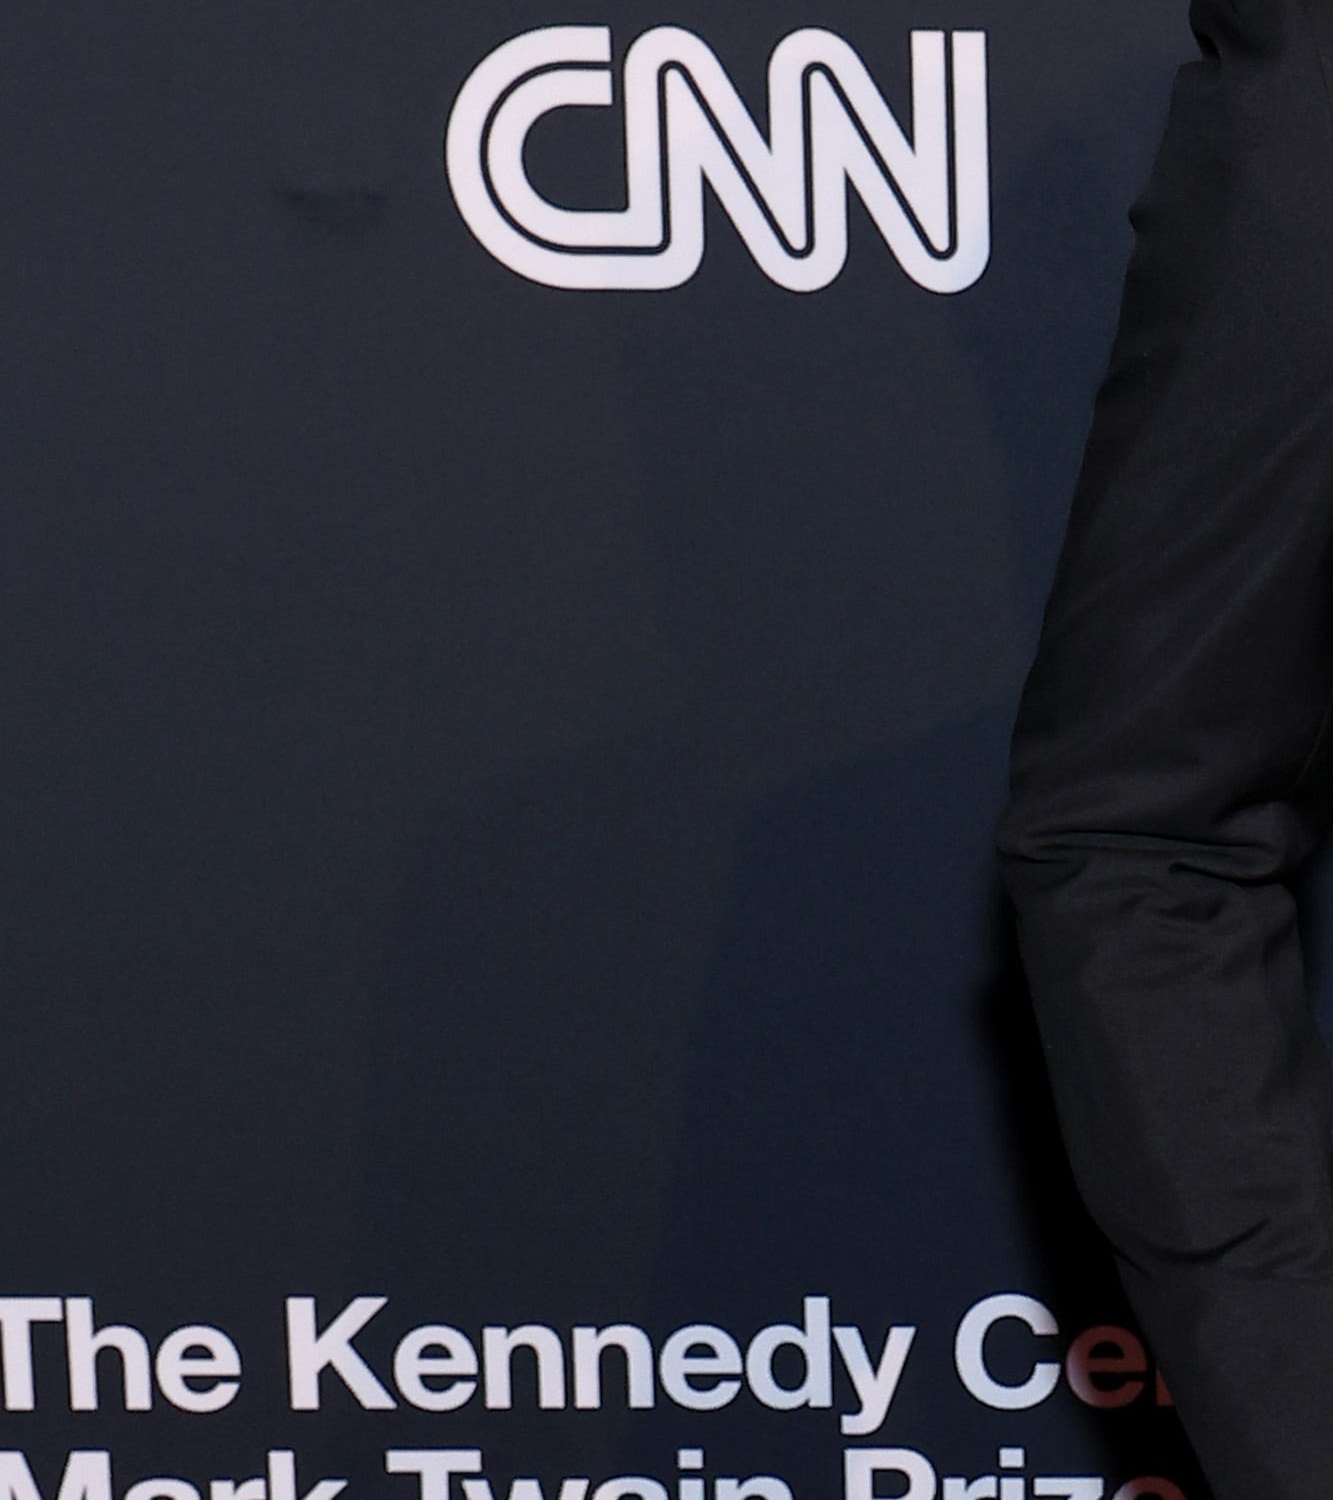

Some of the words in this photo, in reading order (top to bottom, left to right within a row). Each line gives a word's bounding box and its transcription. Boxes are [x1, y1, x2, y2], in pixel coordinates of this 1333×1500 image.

[445, 25, 990, 294] CNN
[0, 1295, 242, 1413] The
[285, 1295, 917, 1437] Kennedy
